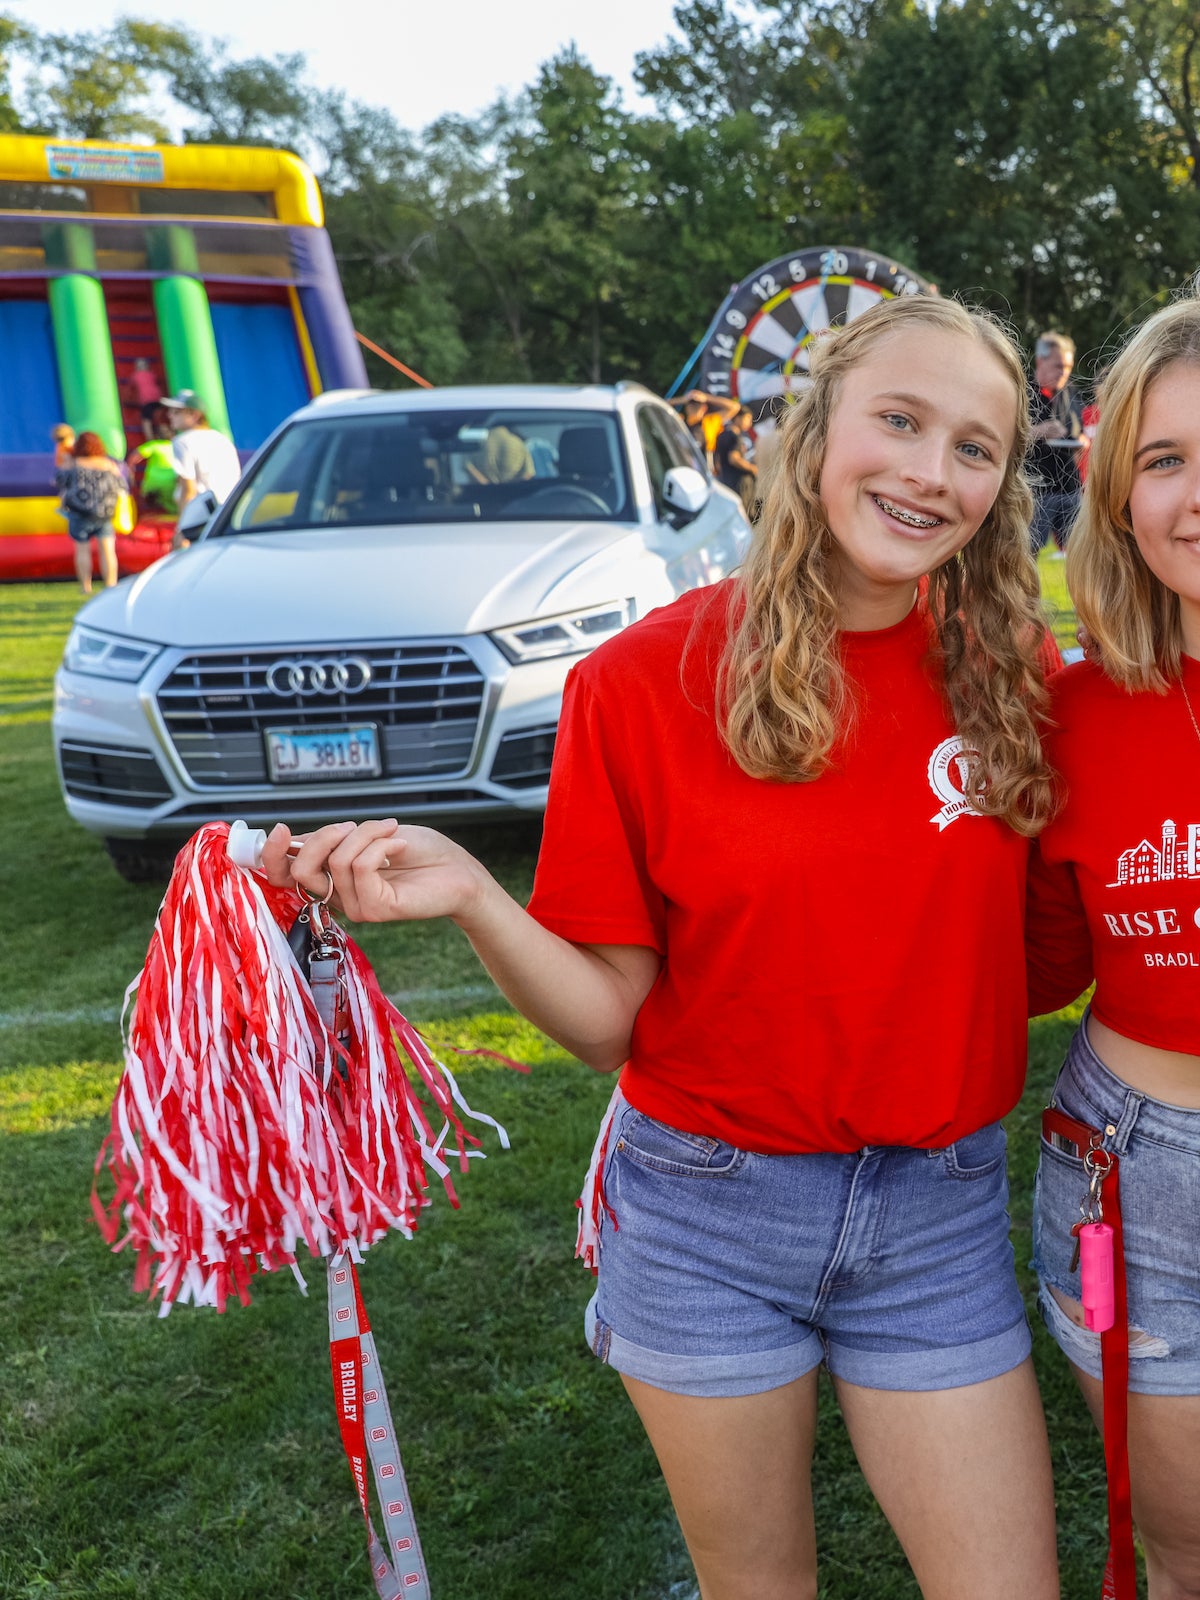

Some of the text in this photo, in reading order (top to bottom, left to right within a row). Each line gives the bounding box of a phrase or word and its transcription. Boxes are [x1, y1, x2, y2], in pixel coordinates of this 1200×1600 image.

[788, 259, 807, 282] 5
[820, 249, 849, 275] 20
[865, 260, 878, 281] 1
[752, 274, 781, 300] 12
[725, 309, 748, 329] 9
[711, 333, 736, 358] 14
[707, 371, 729, 394] 11
[1103, 908, 1181, 936] RISE
[340, 1360, 358, 1422] BRADLEY
